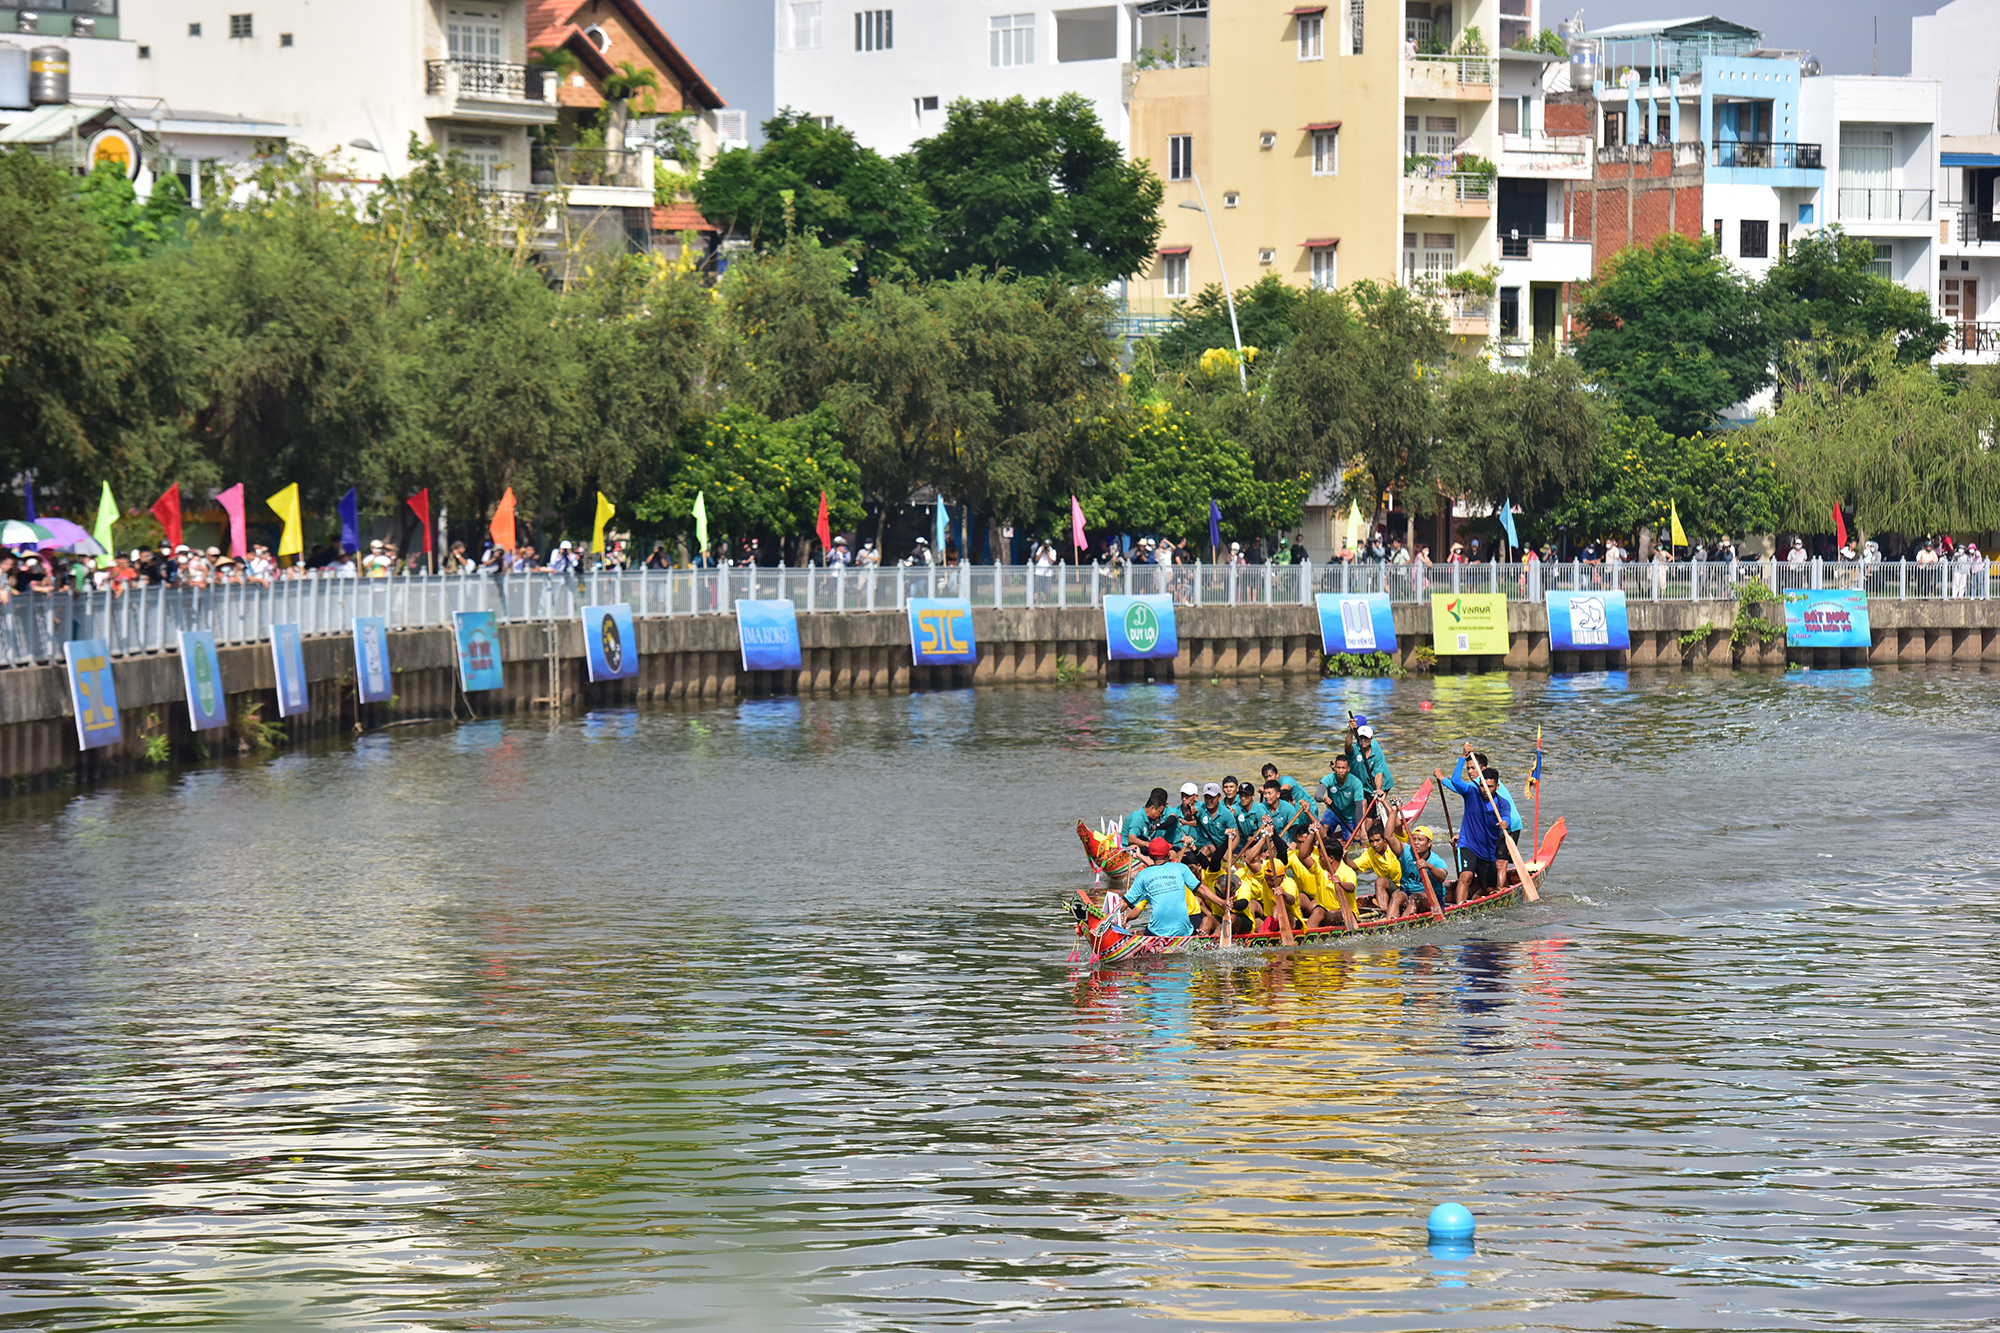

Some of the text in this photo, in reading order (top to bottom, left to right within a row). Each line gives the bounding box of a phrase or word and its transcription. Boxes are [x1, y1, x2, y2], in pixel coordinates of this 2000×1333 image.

[1462, 606, 1491, 615] VINAMA
[918, 609, 969, 654] STC
[1130, 628, 1144, 640] DUY
